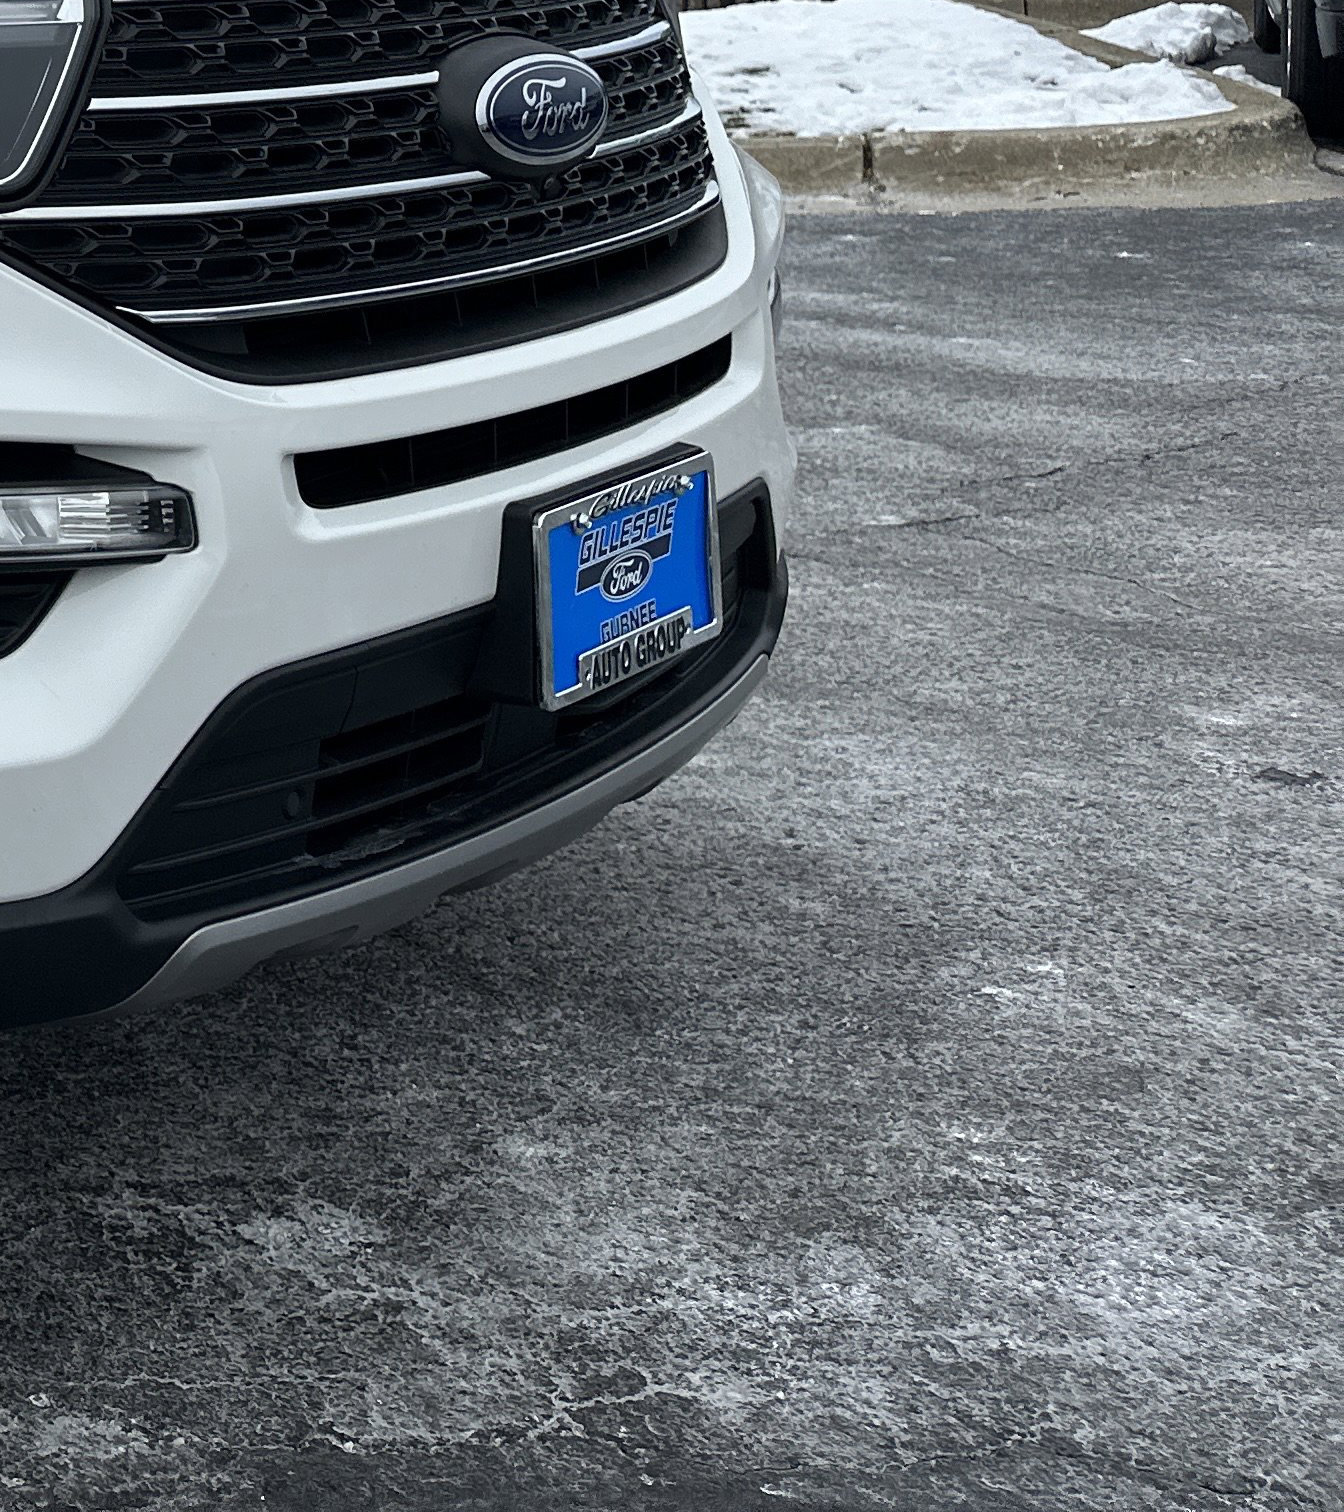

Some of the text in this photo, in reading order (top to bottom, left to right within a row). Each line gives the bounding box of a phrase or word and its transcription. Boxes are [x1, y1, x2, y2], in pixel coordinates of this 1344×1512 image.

[520, 77, 590, 140] Ford
[578, 497, 679, 569] GILLESPIE
[610, 558, 643, 595] Ford
[591, 615, 686, 690] AUTO GROUP
[600, 598, 658, 644] GURNEE
